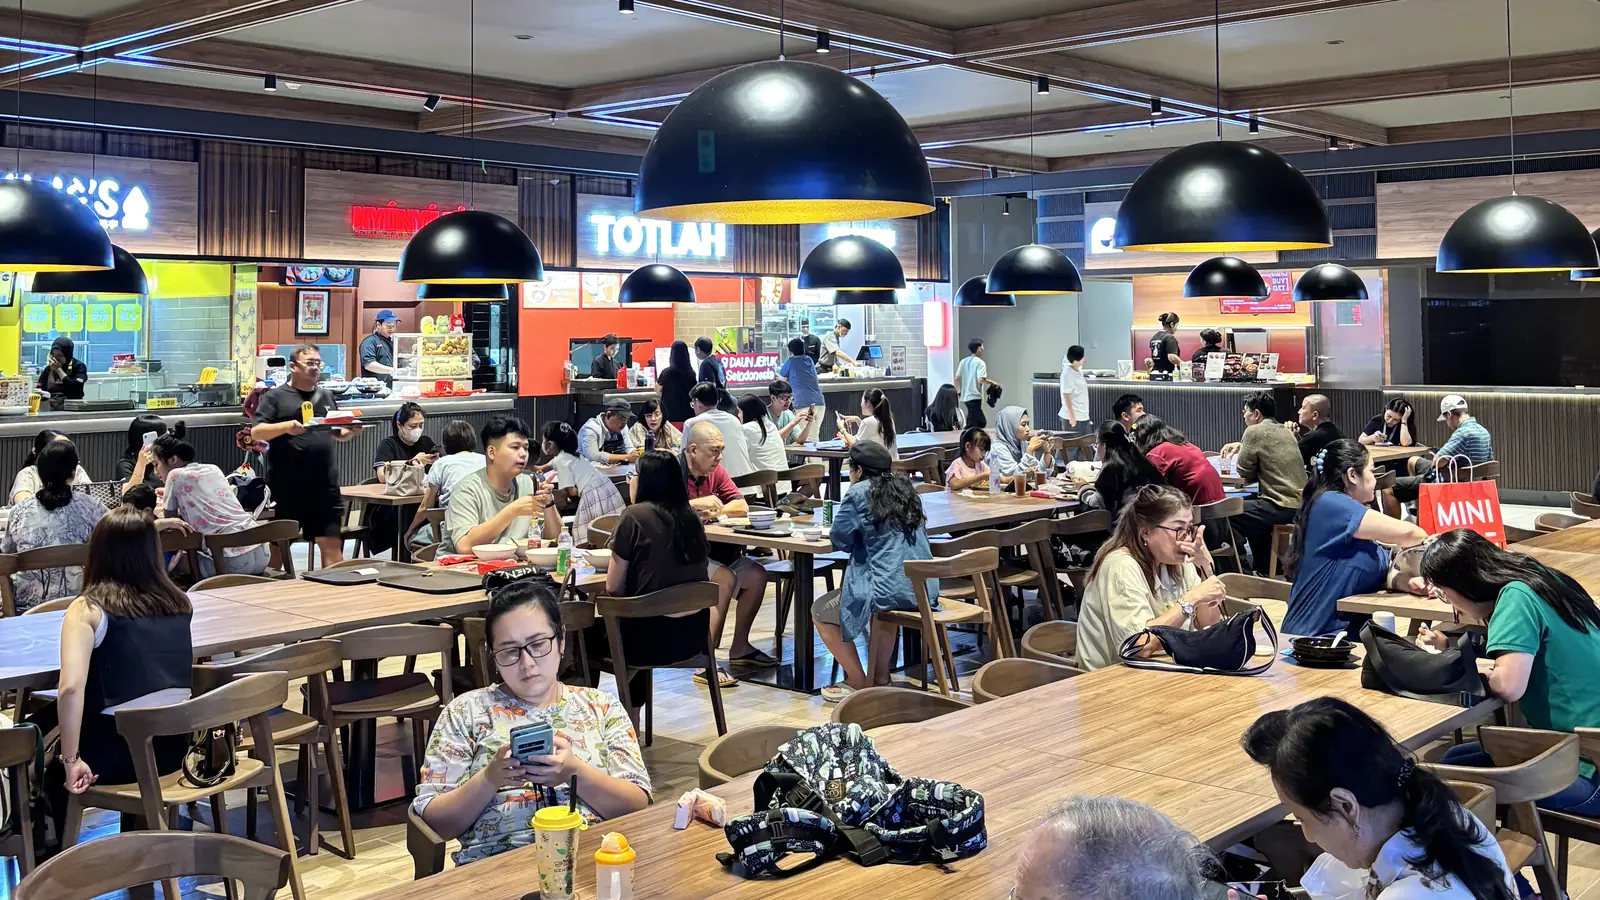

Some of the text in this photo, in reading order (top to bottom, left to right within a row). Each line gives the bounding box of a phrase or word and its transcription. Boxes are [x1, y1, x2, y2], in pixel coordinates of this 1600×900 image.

[590, 214, 727, 257] TOTLAH
[729, 356, 754, 368] DAUN
[754, 355, 778, 367] JERUK
[1437, 499, 1494, 527] MINI
